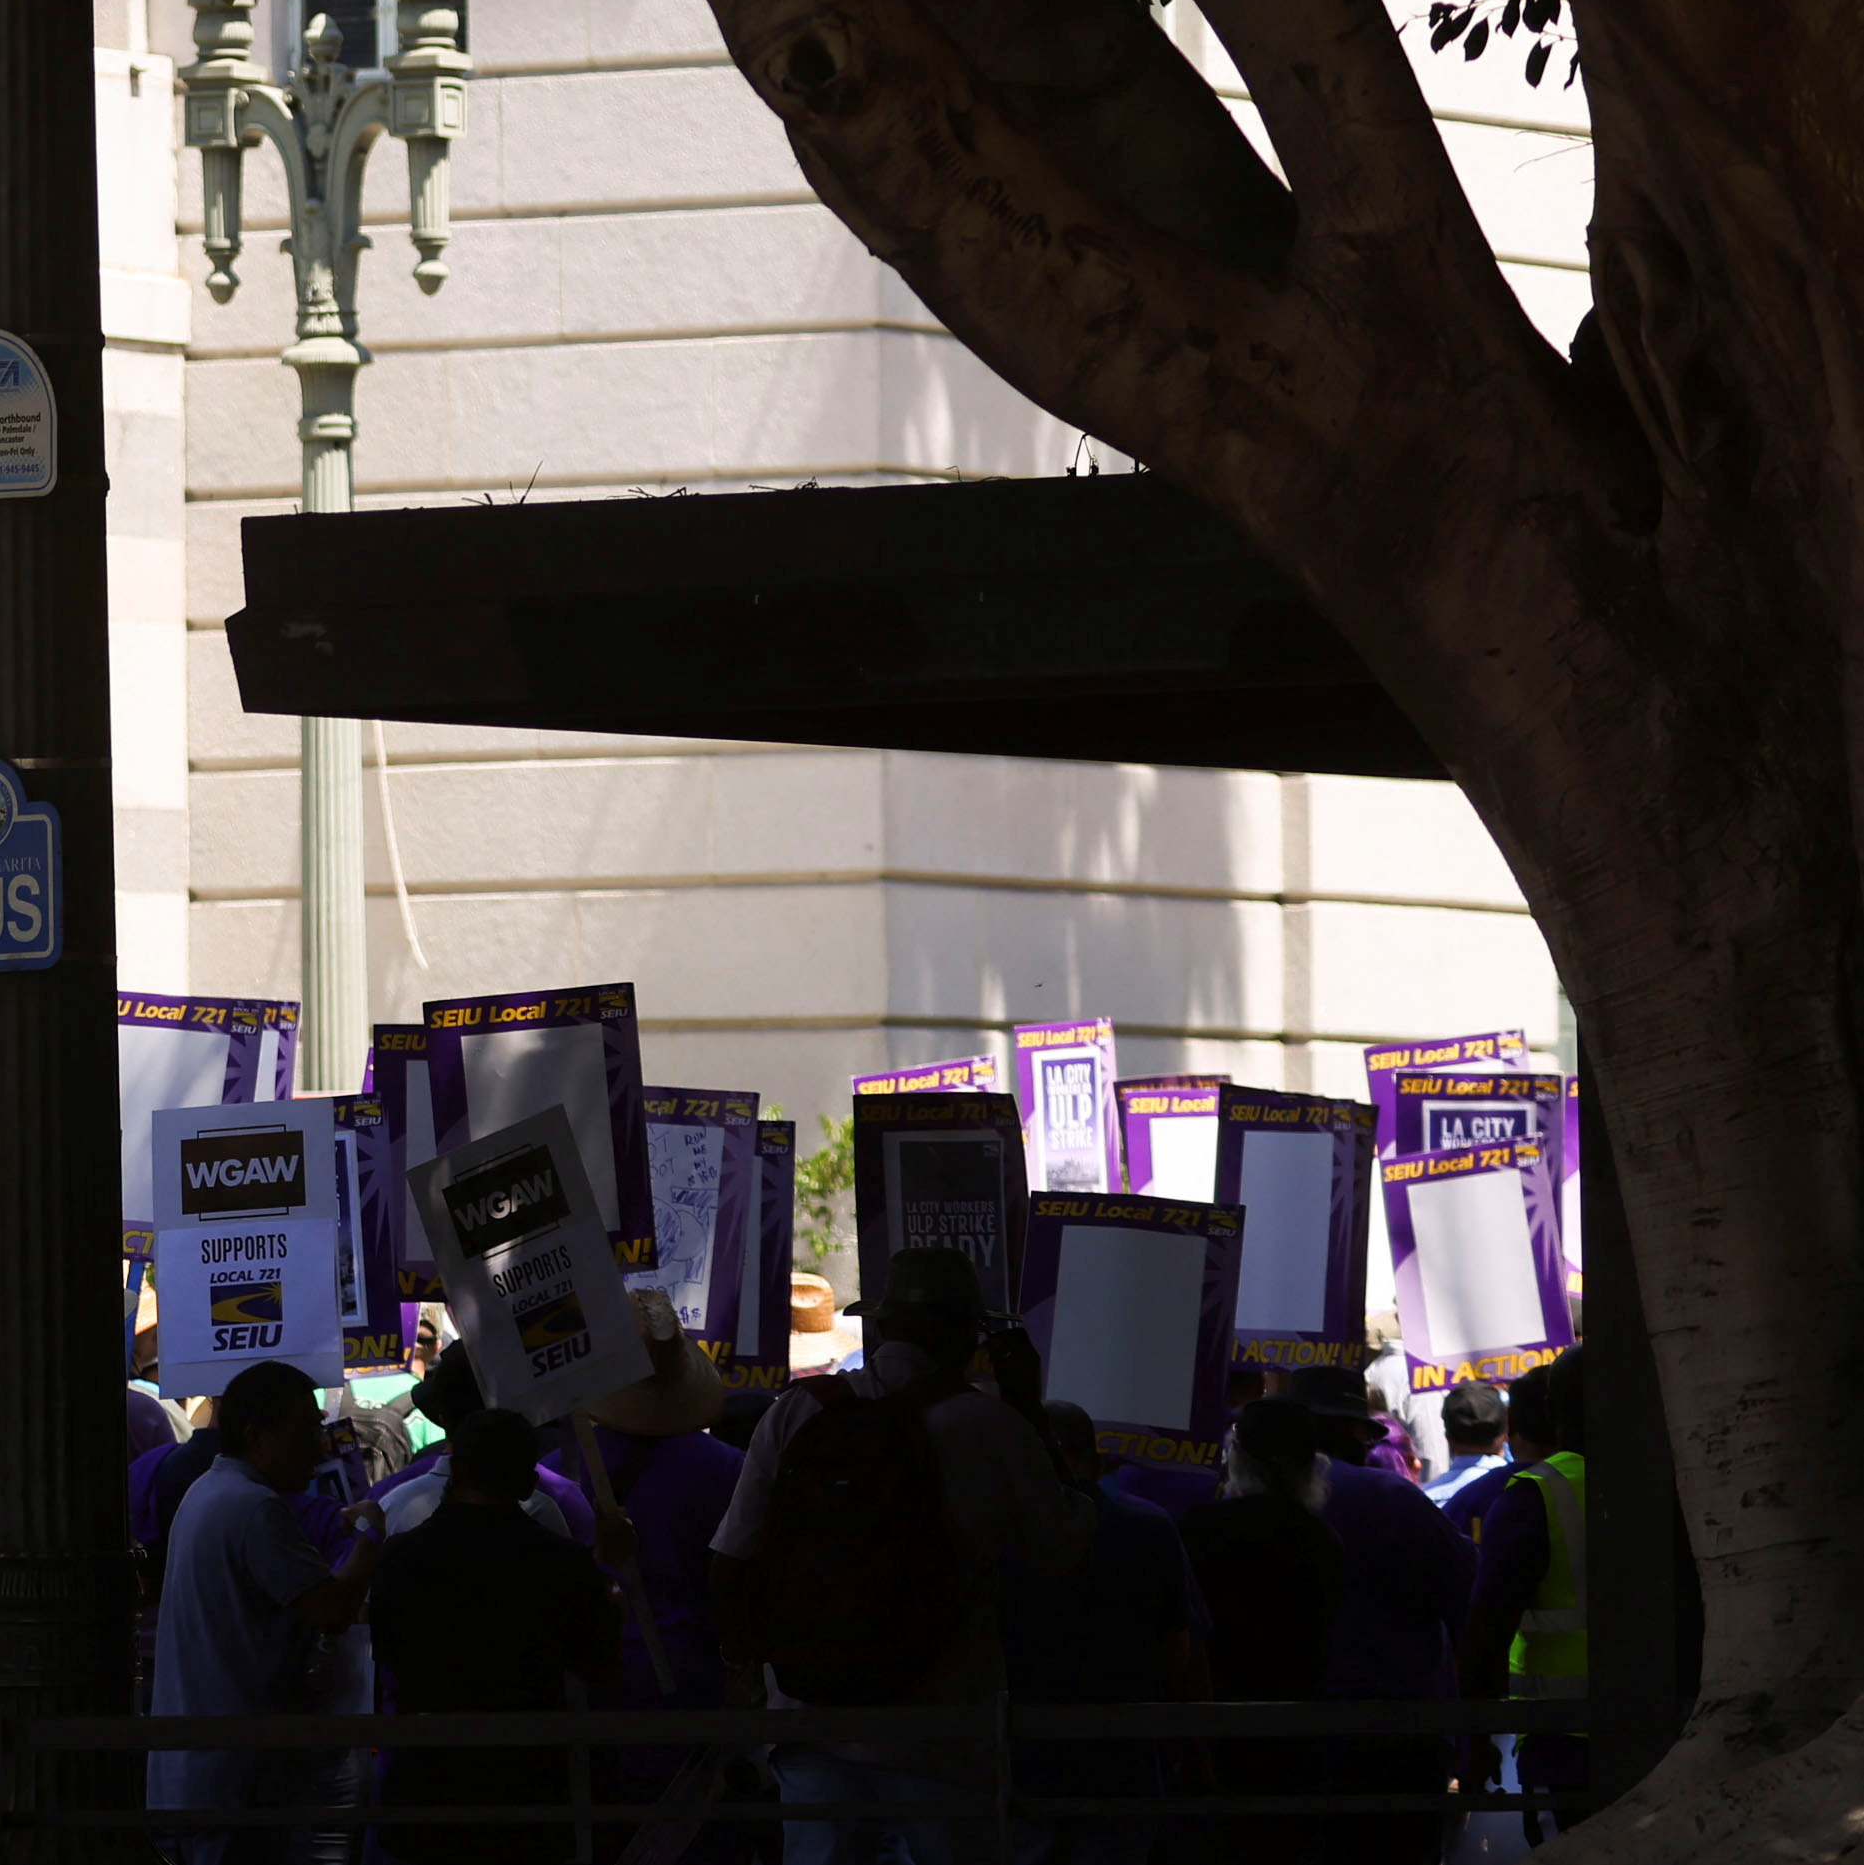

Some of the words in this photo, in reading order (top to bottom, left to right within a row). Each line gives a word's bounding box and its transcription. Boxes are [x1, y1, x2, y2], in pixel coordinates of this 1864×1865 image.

[2, 424, 31, 434] Palmdale
[20, 447, 35, 457] Only
[134, 1002, 186, 1022] Local
[190, 1005, 227, 1025] 721
[430, 1007, 482, 1030] SEIU
[489, 1000, 547, 1024] Local
[554, 997, 592, 1017] 721
[1368, 1049, 1409, 1071] SEIU
[1415, 1045, 1458, 1068] Local
[1462, 1038, 1495, 1061] 721
[1047, 1093, 1093, 1128] ULP
[1229, 1103, 1258, 1123] SEIU
[1260, 1105, 1300, 1123] Local
[1305, 1107, 1329, 1124] 721
[1441, 1117, 1463, 1138] LA
[1471, 1117, 1516, 1138] CITY
[185, 1154, 301, 1190] WGAW
[1383, 1159, 1425, 1182] SEIU
[1429, 1153, 1475, 1177] Local
[1479, 1148, 1511, 1169] 721
[454, 1168, 556, 1234] WGAW
[919, 1201, 941, 1215] CITY
[943, 1200, 996, 1215] WORKERS
[1034, 1200, 1087, 1219] SEIU
[1095, 1202, 1155, 1222] Local
[1161, 1208, 1201, 1227] 721
[907, 1214, 935, 1234] ULP
[938, 1214, 996, 1234] STRIKE
[201, 1232, 288, 1265] SUPPORTS
[209, 1269, 255, 1284] LOCAL
[259, 1267, 281, 1281] 721
[492, 1244, 572, 1299] SUPPORTS
[213, 1324, 283, 1352] SEIU
[1241, 1338, 1341, 1366] ACTION!
[532, 1338, 592, 1379] SEIU
[1412, 1364, 1446, 1390] IN
